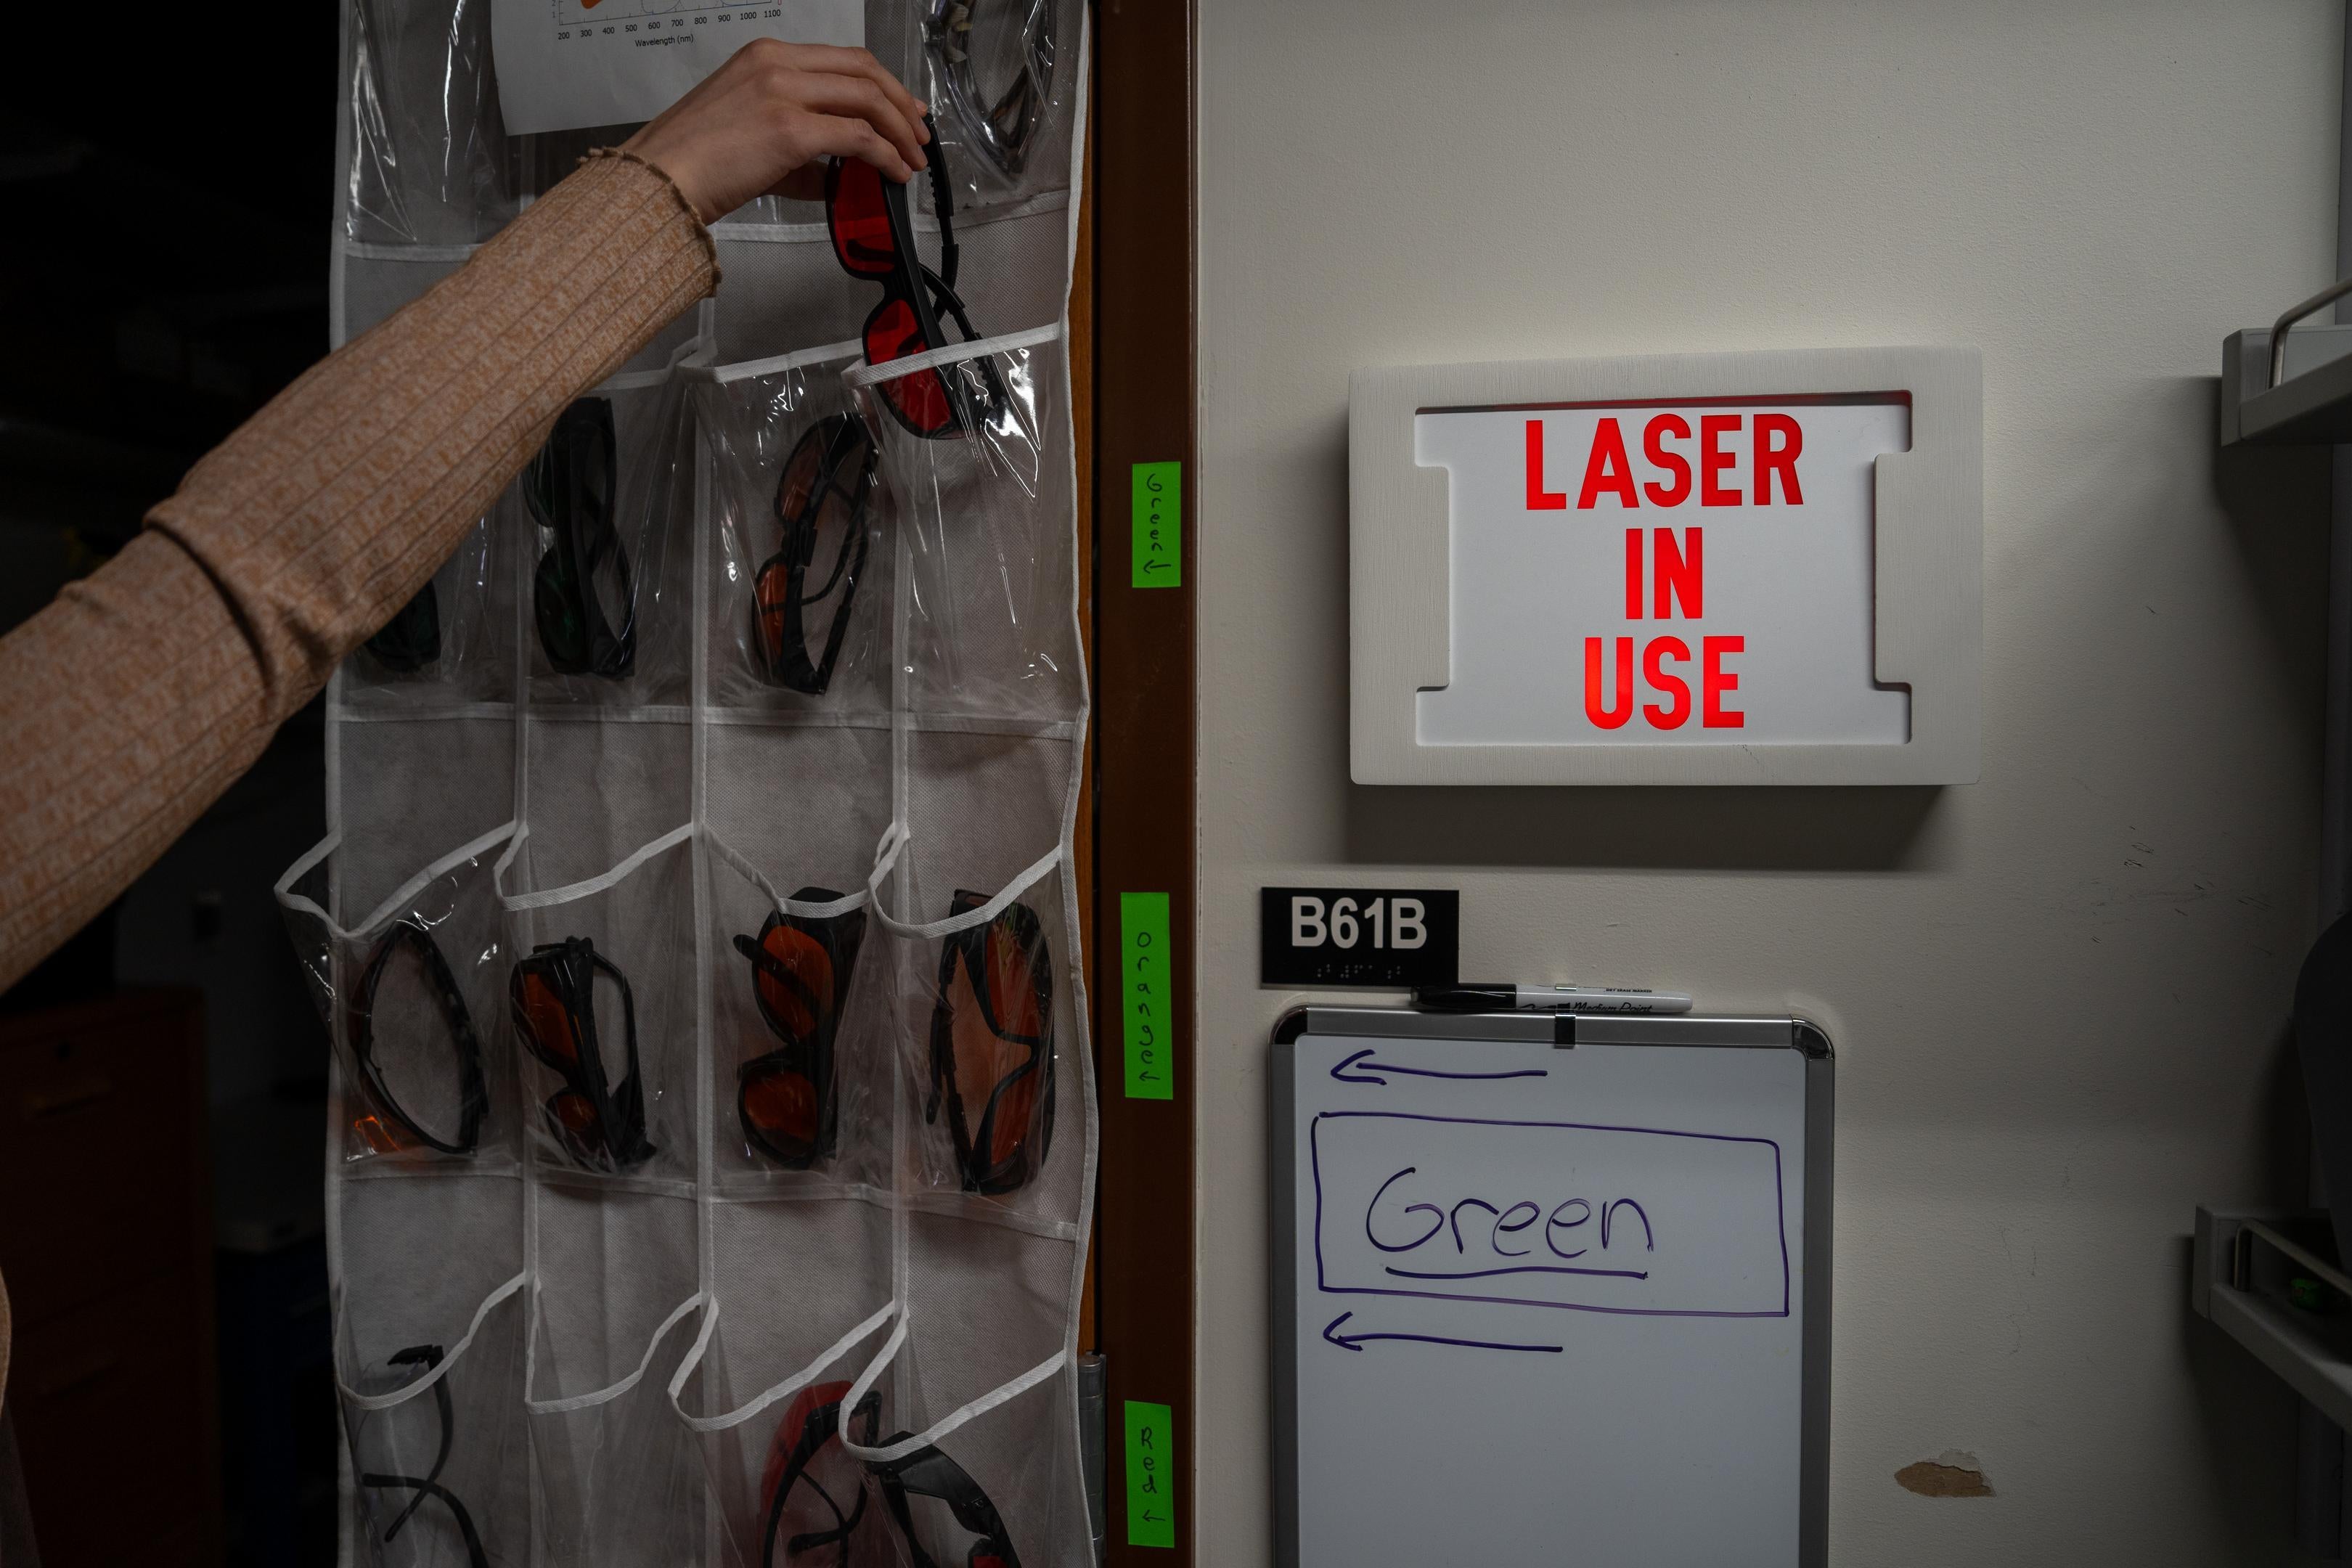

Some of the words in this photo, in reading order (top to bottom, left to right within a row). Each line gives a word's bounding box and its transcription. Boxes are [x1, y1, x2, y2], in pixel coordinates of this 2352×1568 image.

[625, 24, 637, 33] 500
[740, 12, 757, 20] 1000
[764, 9, 781, 18] 1100
[634, 36, 675, 47] Wavelength
[677, 34, 694, 44] (nm)
[1526, 413, 1804, 510] LASER
[1146, 473, 1163, 551] Green
[1625, 526, 1703, 620] IN
[1585, 635, 1744, 730] USE
[1291, 896, 1428, 950] B61B
[1137, 932, 1154, 1064] Orange
[1365, 1167, 1654, 1259] Green
[1140, 1426, 1158, 1494] Red
